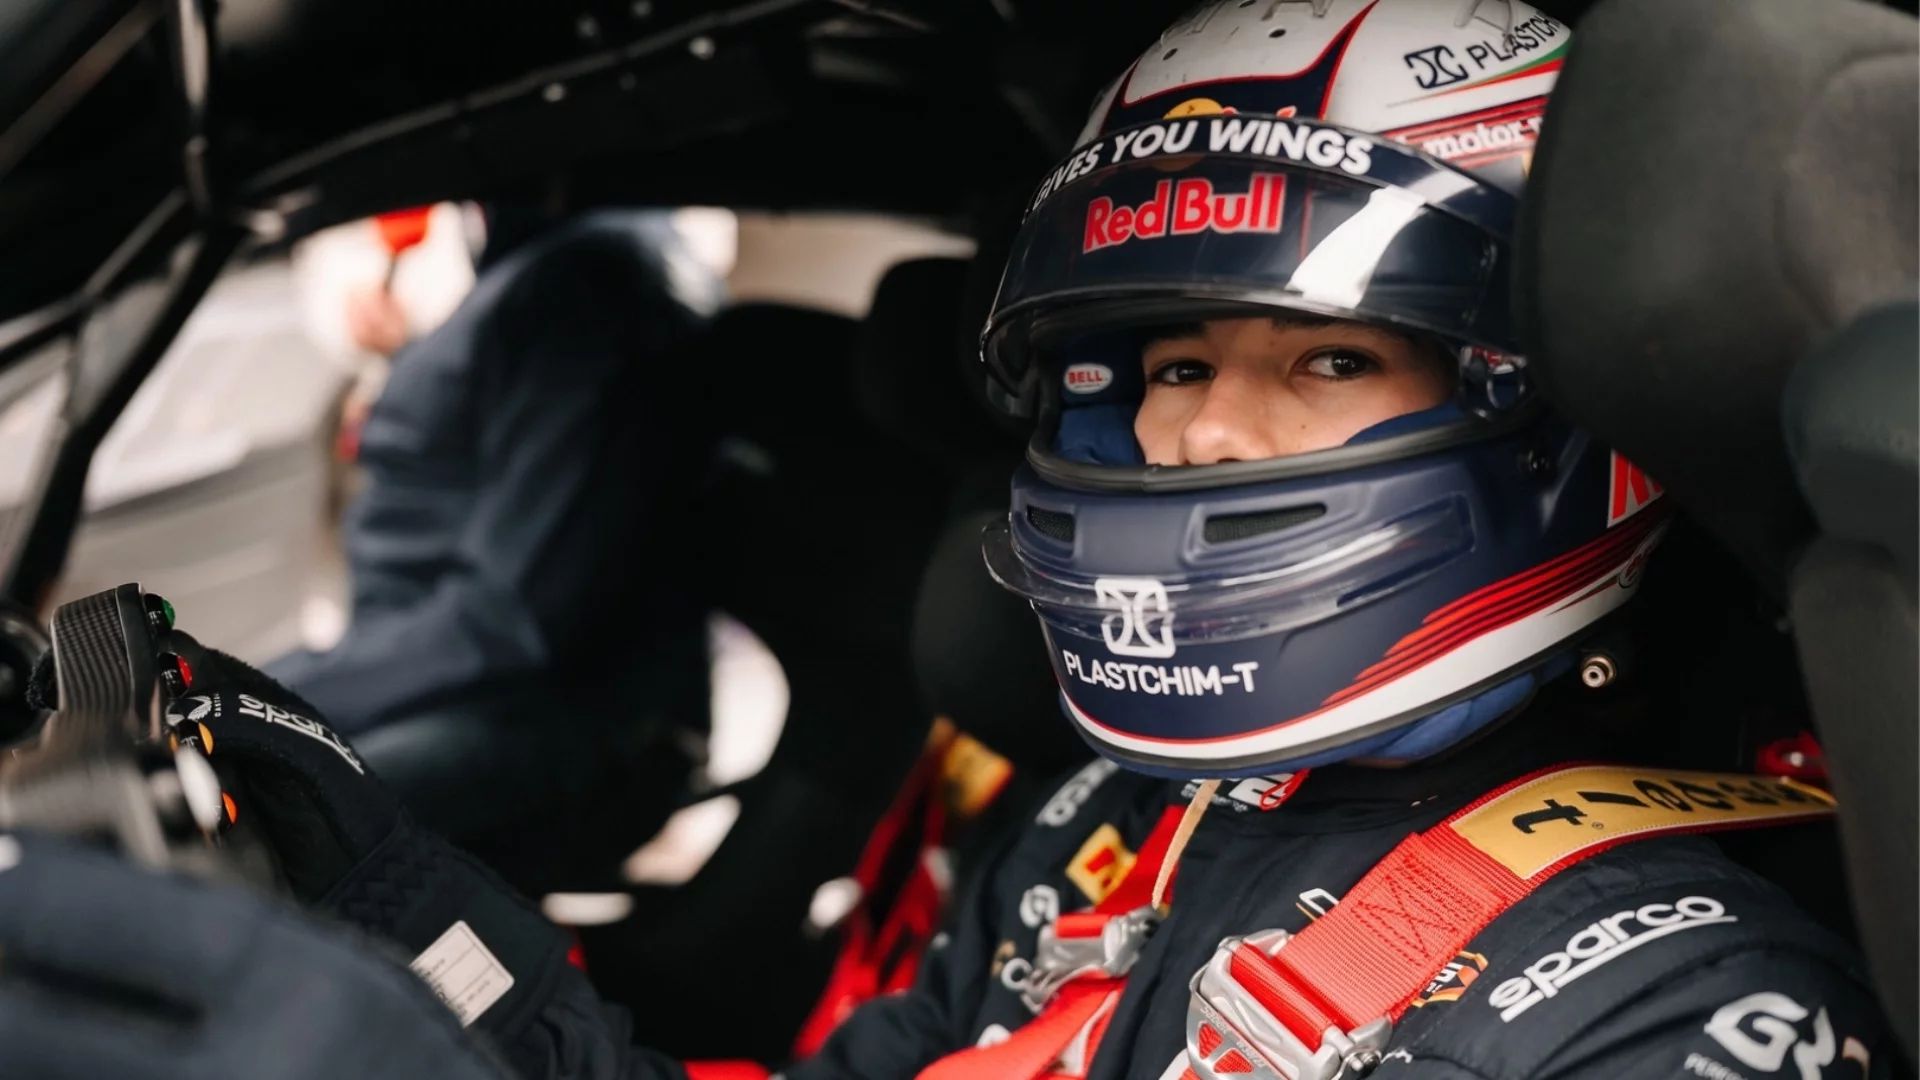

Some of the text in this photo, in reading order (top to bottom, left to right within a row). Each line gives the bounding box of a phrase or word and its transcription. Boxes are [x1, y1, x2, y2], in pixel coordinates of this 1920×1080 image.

[1033, 119, 1374, 211] GIVES YOU WINGS
[1067, 370, 1103, 384] BELL
[1062, 649, 1259, 696] PLASTCHIM-T
[1488, 896, 1738, 1023] sparco
